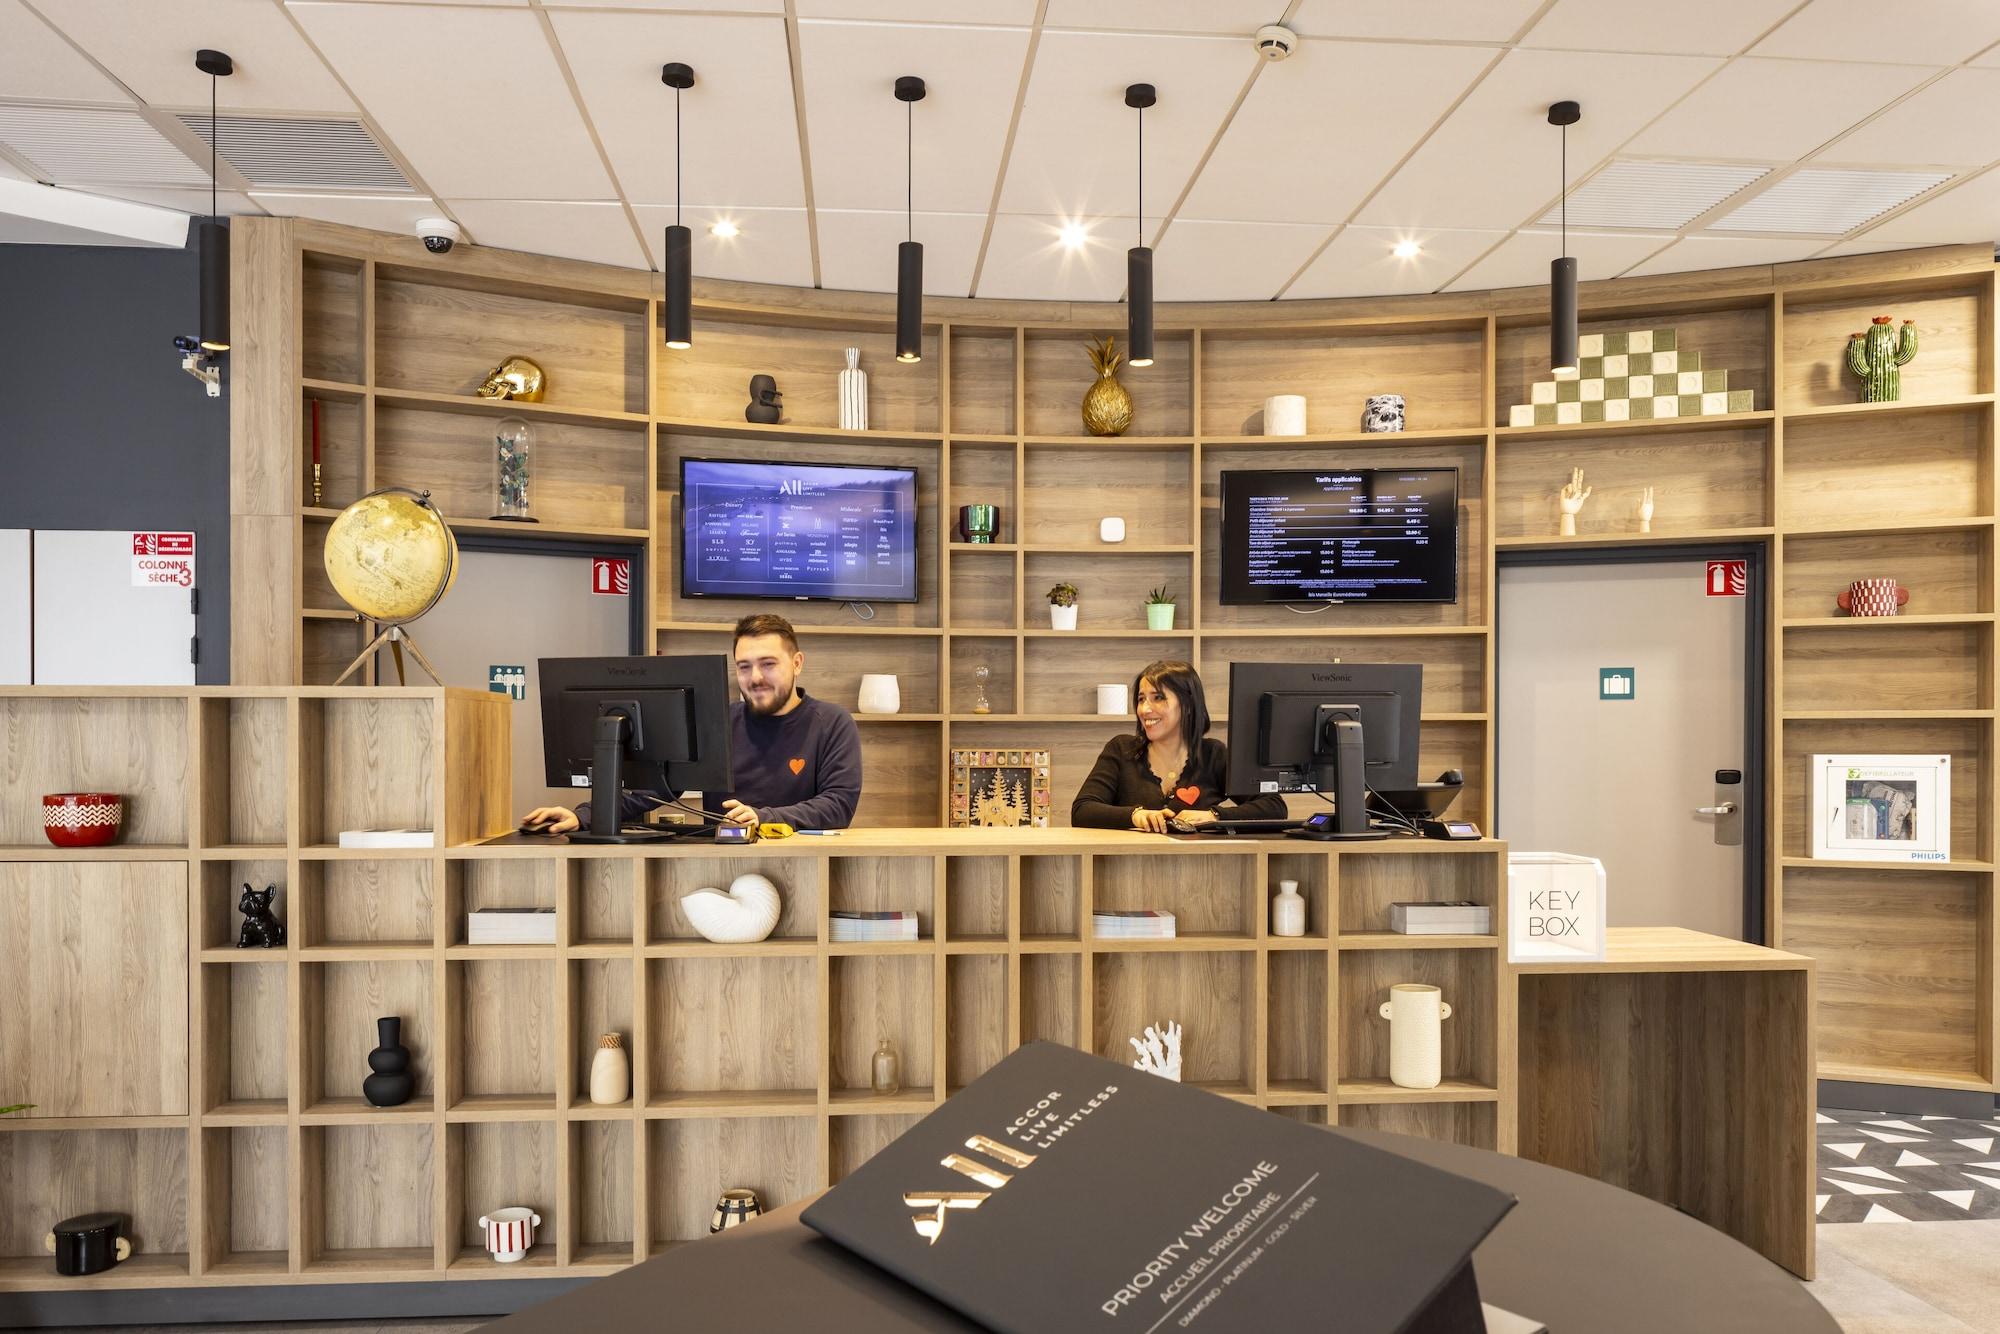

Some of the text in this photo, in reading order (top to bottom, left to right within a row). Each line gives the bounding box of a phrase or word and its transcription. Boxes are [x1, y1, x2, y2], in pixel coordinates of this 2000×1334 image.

[779, 479, 802, 496] All
[138, 560, 188, 570] COLONNE
[148, 567, 192, 587] SÈCHE 3
[1311, 673, 1353, 683] ViewSonic
[1911, 852, 1946, 860] PHILIPS
[1529, 890, 1580, 910] KEY
[1529, 916, 1580, 936] BOX
[1005, 1090, 1062, 1136] ACCOR
[1037, 1085, 1119, 1150] LIMITLESS
[1020, 1112, 1060, 1142] LIVE
[1101, 1160, 1278, 1317] PRIORITY WELCOME
[1159, 1191, 1281, 1304] ACCUEIL PRIORITAIRE
[1178, 1287, 1221, 1327] DIAMOND
[1222, 1246, 1265, 1286] PLATINUM
[1265, 1223, 1289, 1246] GOLD
[1289, 1195, 1318, 1222] SILVER
